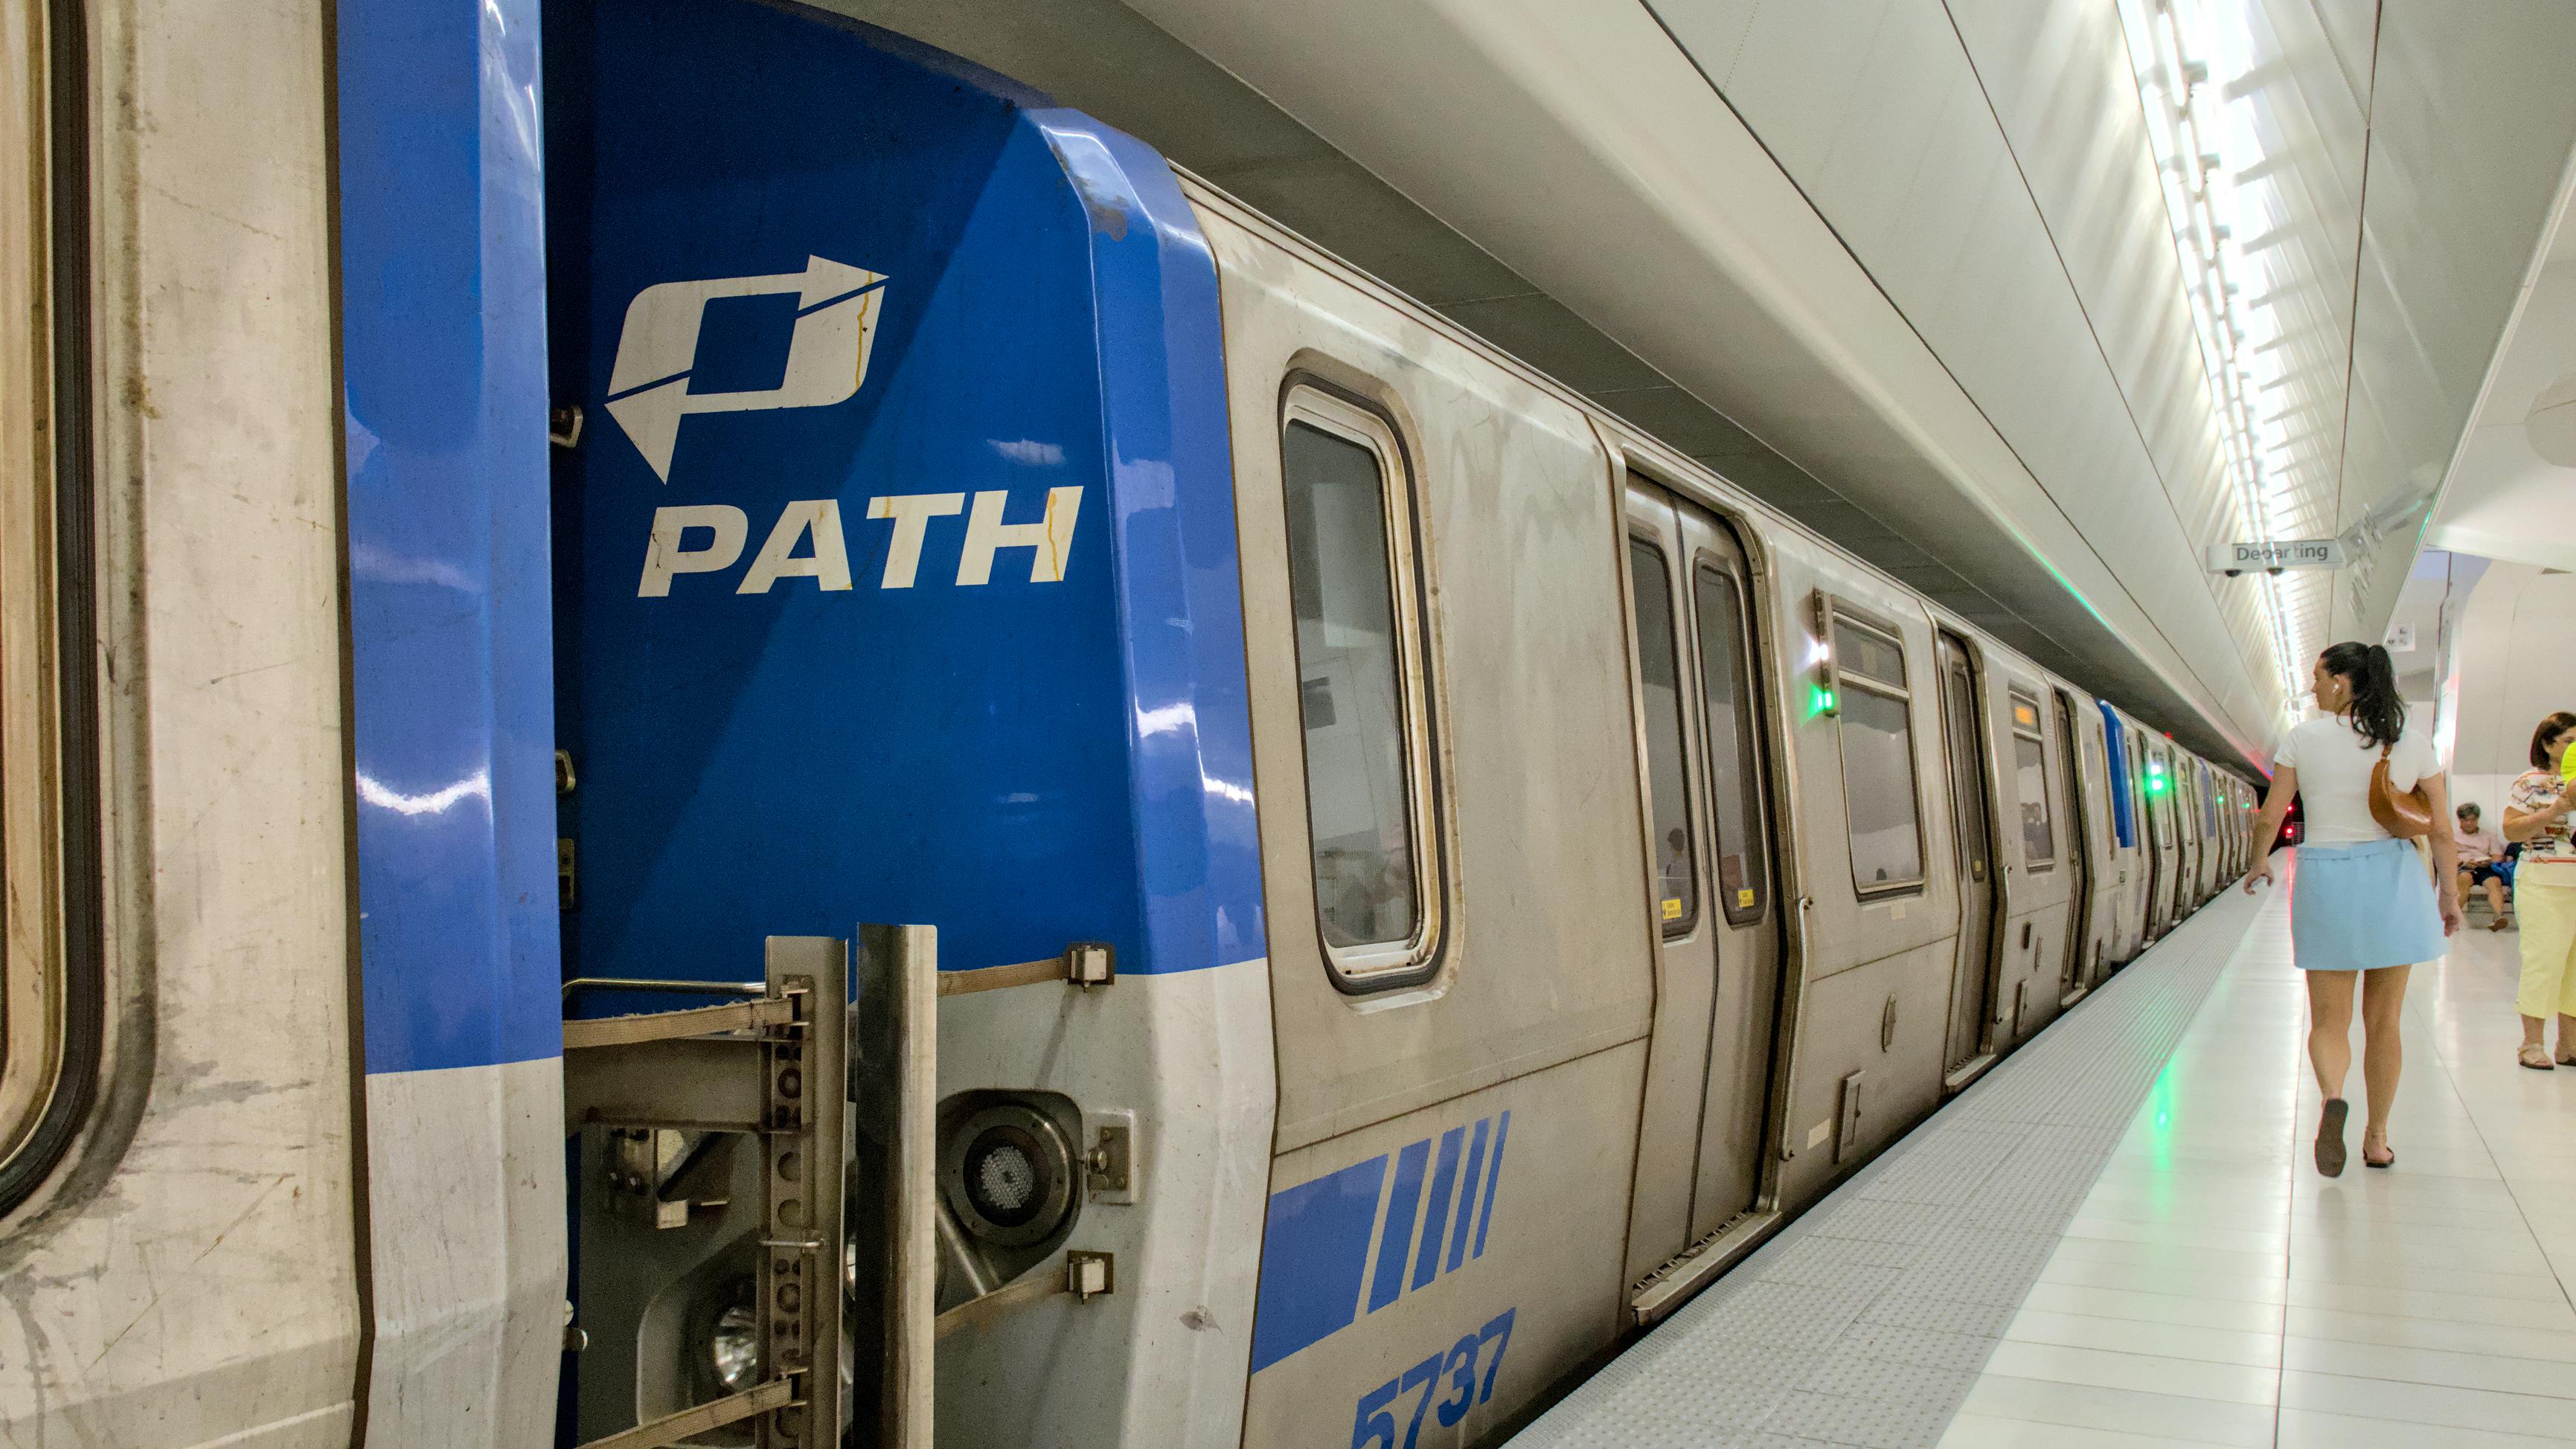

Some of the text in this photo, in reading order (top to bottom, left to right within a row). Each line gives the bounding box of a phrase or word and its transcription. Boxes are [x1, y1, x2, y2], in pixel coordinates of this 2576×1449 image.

[638, 486, 1084, 597] PATH
[2236, 544, 2328, 561] Departing
[1351, 1307, 1516, 1449] 5737
